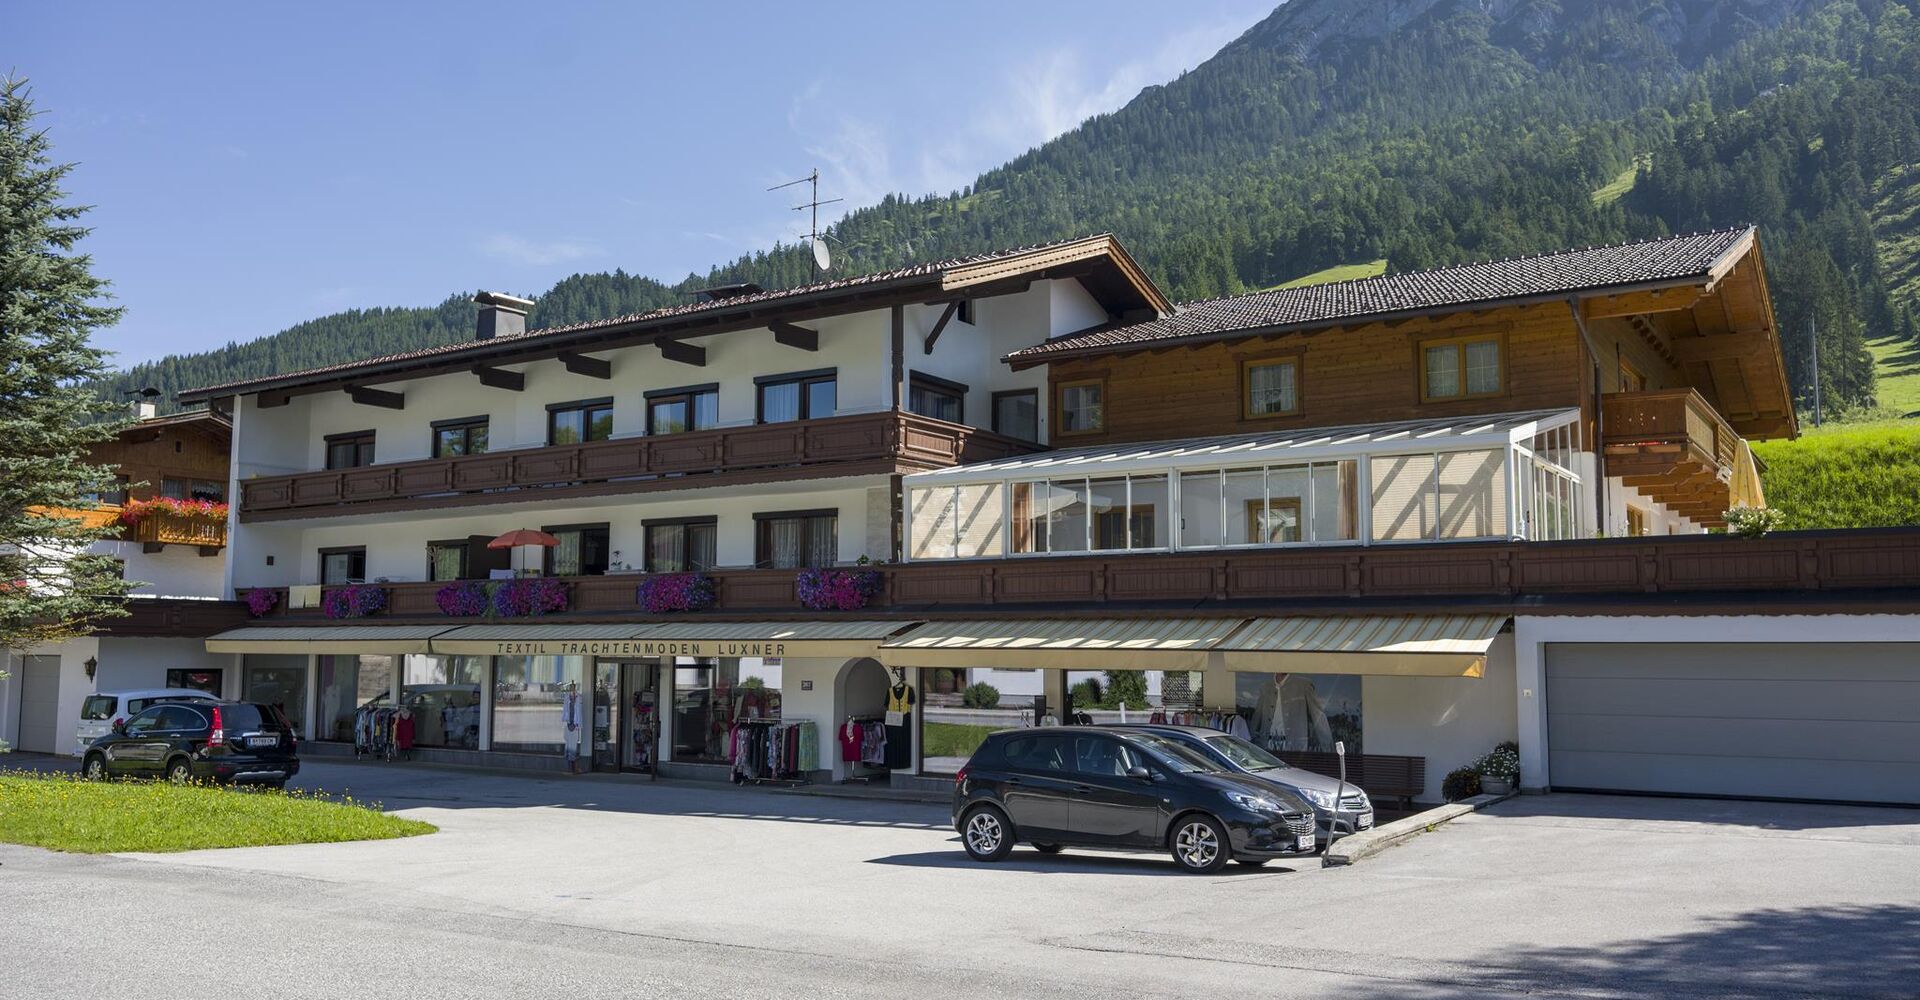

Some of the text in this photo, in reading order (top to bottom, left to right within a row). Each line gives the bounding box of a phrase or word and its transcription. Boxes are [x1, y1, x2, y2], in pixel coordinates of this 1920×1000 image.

[497, 643, 785, 655] TEXTIL TRACHTENMODEN LUXNER
